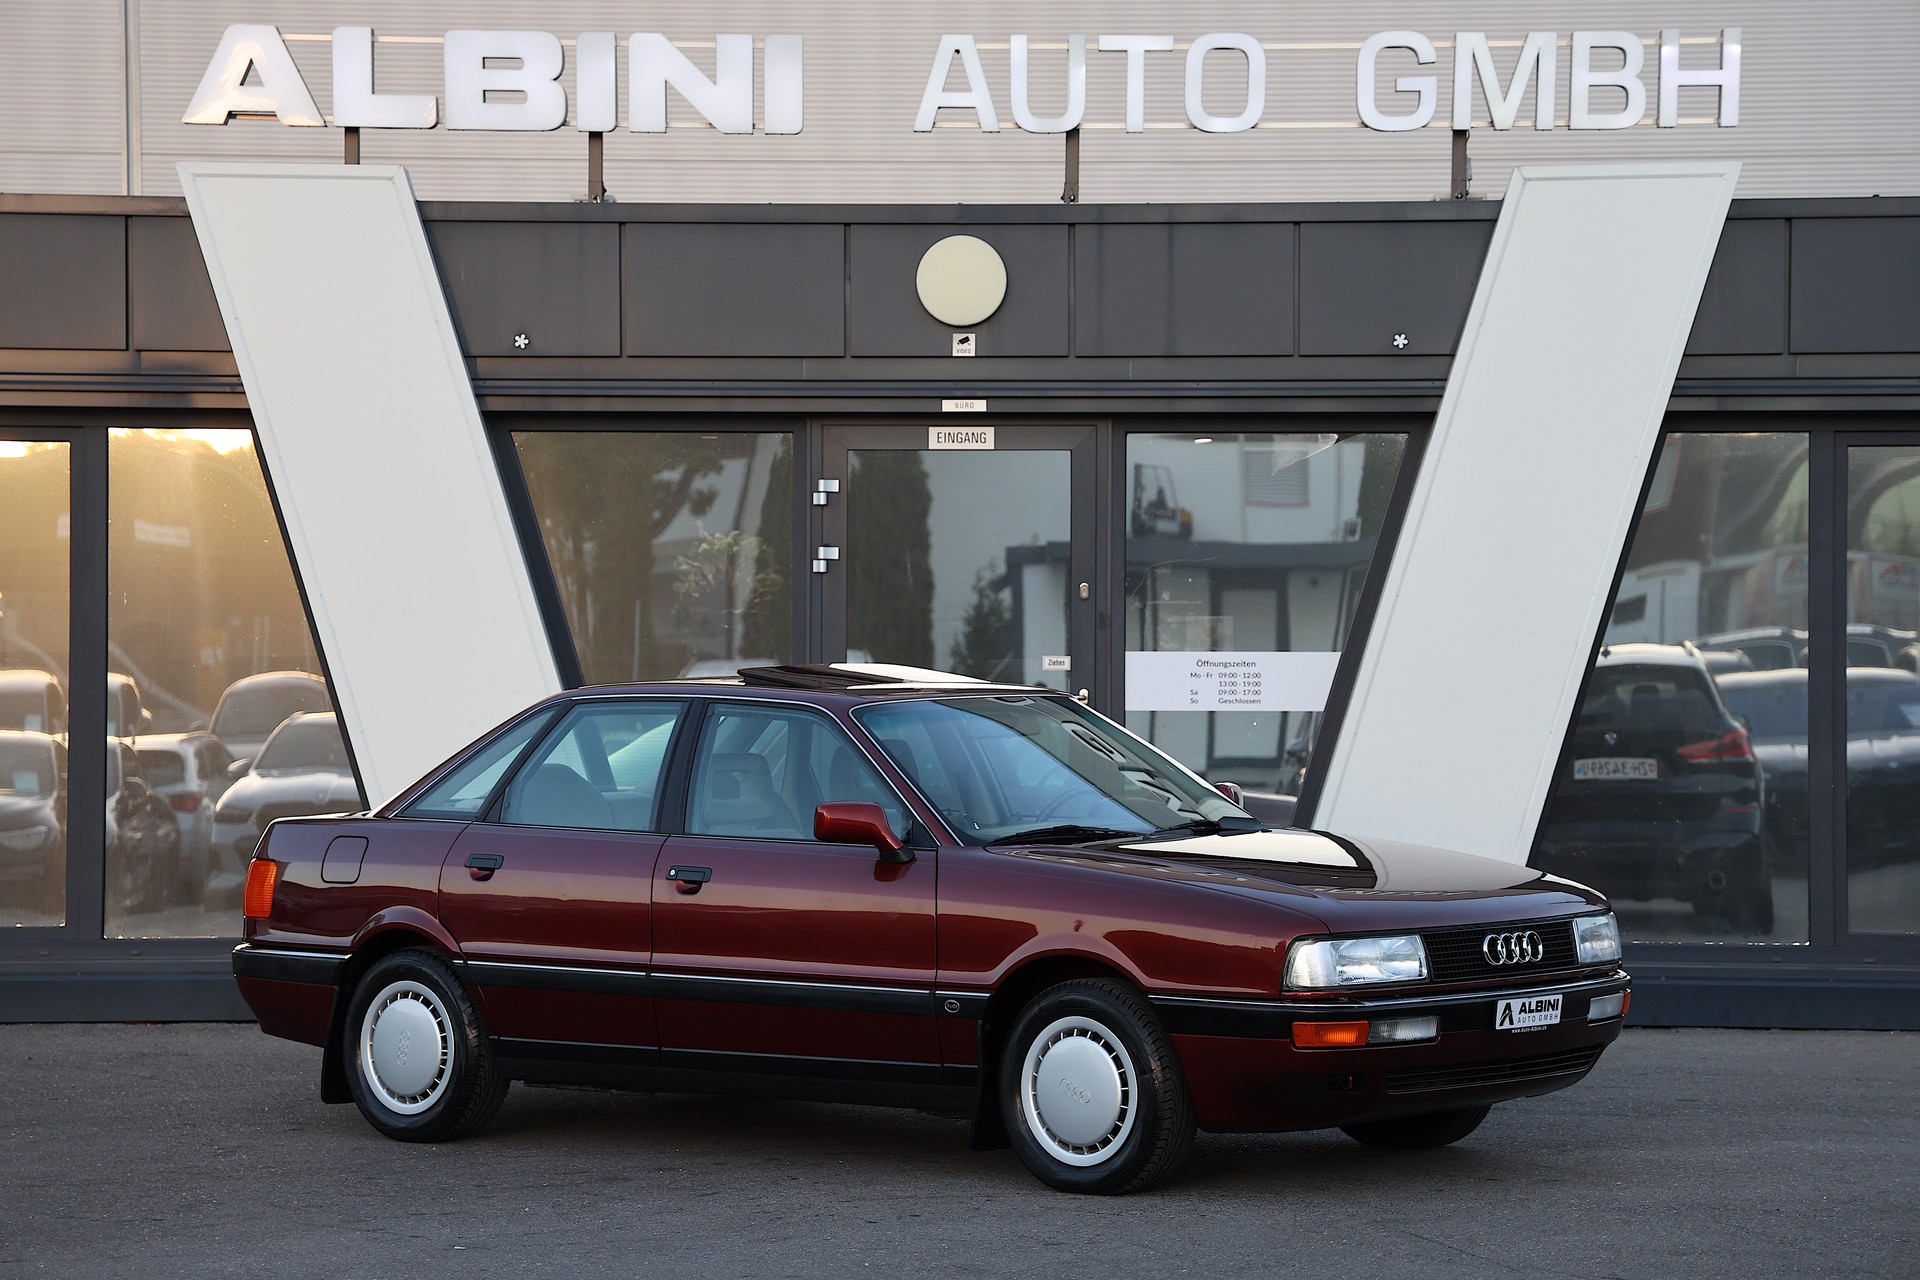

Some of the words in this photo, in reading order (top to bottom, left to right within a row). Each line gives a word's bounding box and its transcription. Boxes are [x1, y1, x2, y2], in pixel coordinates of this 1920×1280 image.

[181, 23, 805, 135] ALBINI
[913, 33, 1267, 134] AUTO
[1356, 28, 1742, 133] GMBH
[954, 400, 975, 409] BÜRO
[936, 432, 987, 444] EINGANG
[1196, 659, 1256, 668] Öffnungszeiten
[1518, 998, 1560, 1014] ALBINI
[1517, 1016, 1536, 1024] AUTO
[1538, 1014, 1558, 1022] GMBH
